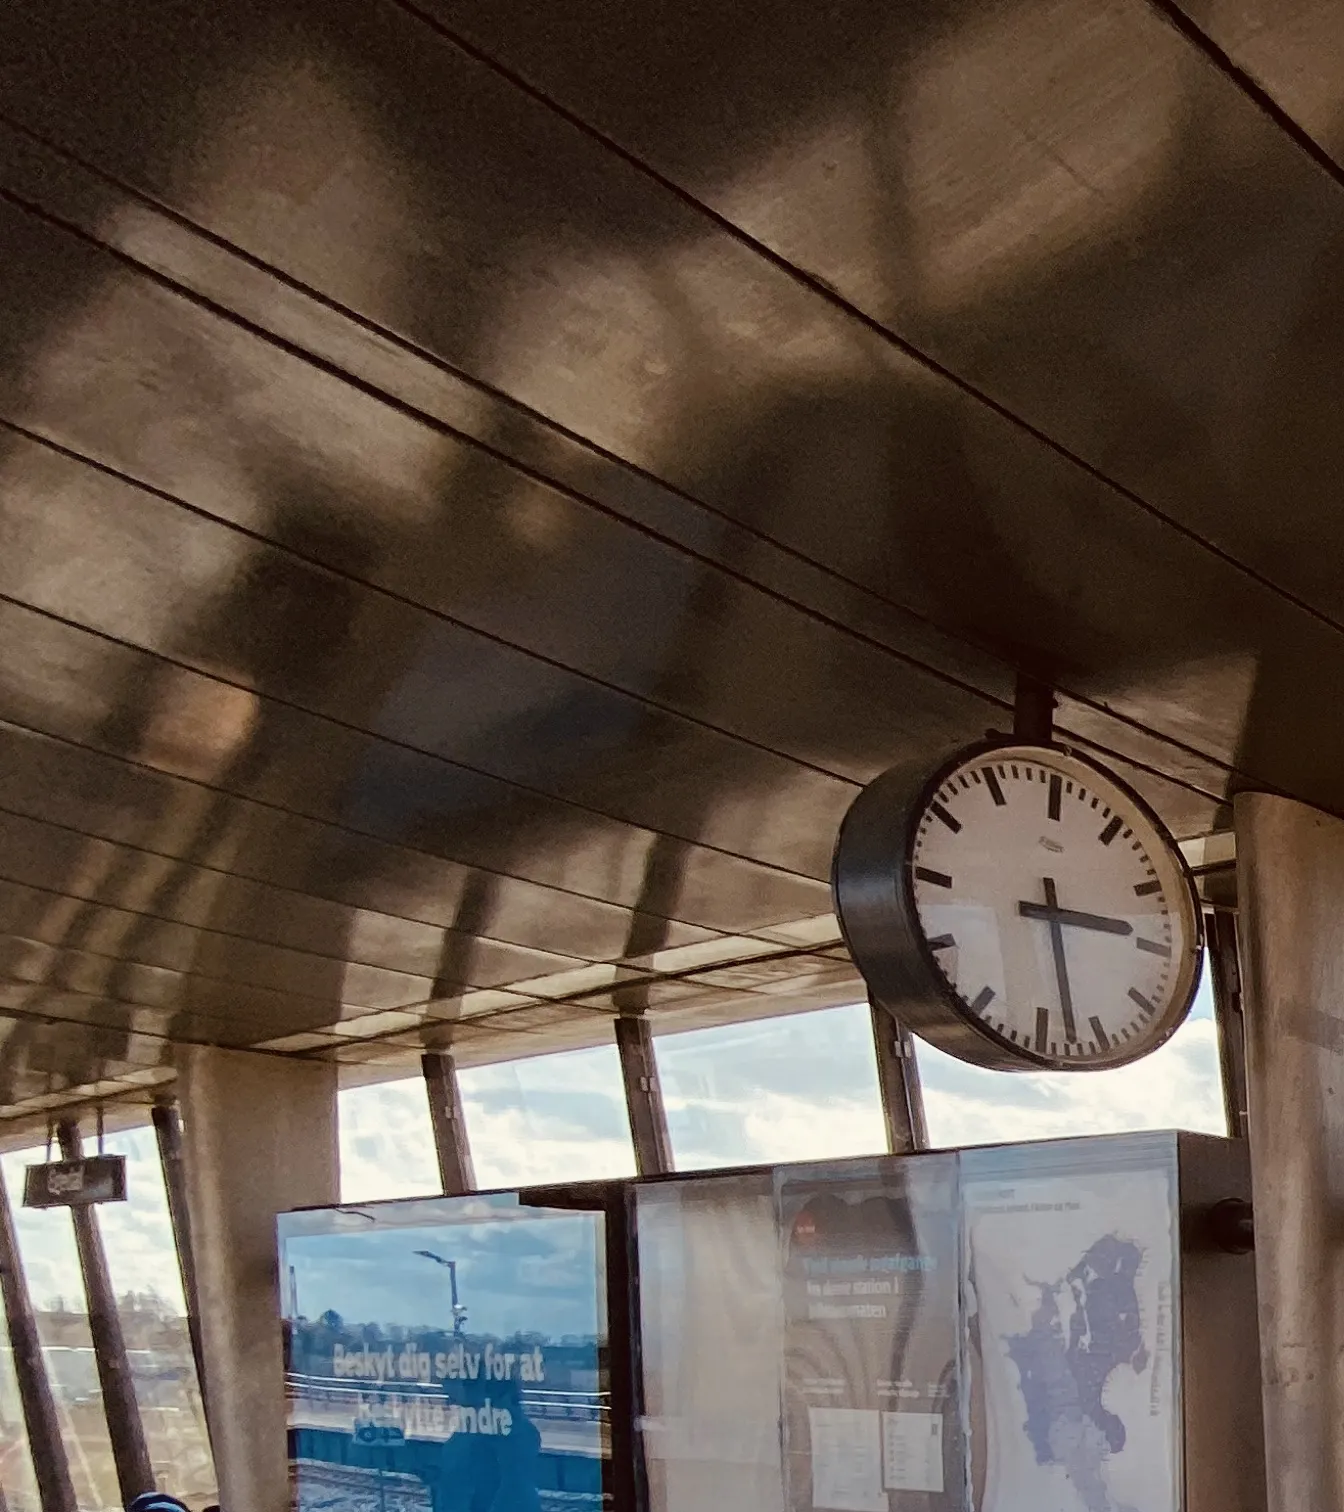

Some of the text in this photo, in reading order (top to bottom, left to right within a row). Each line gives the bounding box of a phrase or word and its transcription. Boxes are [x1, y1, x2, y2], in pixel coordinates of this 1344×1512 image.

[399, 1342, 431, 1383] dig
[434, 1342, 481, 1380] selv
[484, 1343, 516, 1381] for
[519, 1345, 545, 1382] at
